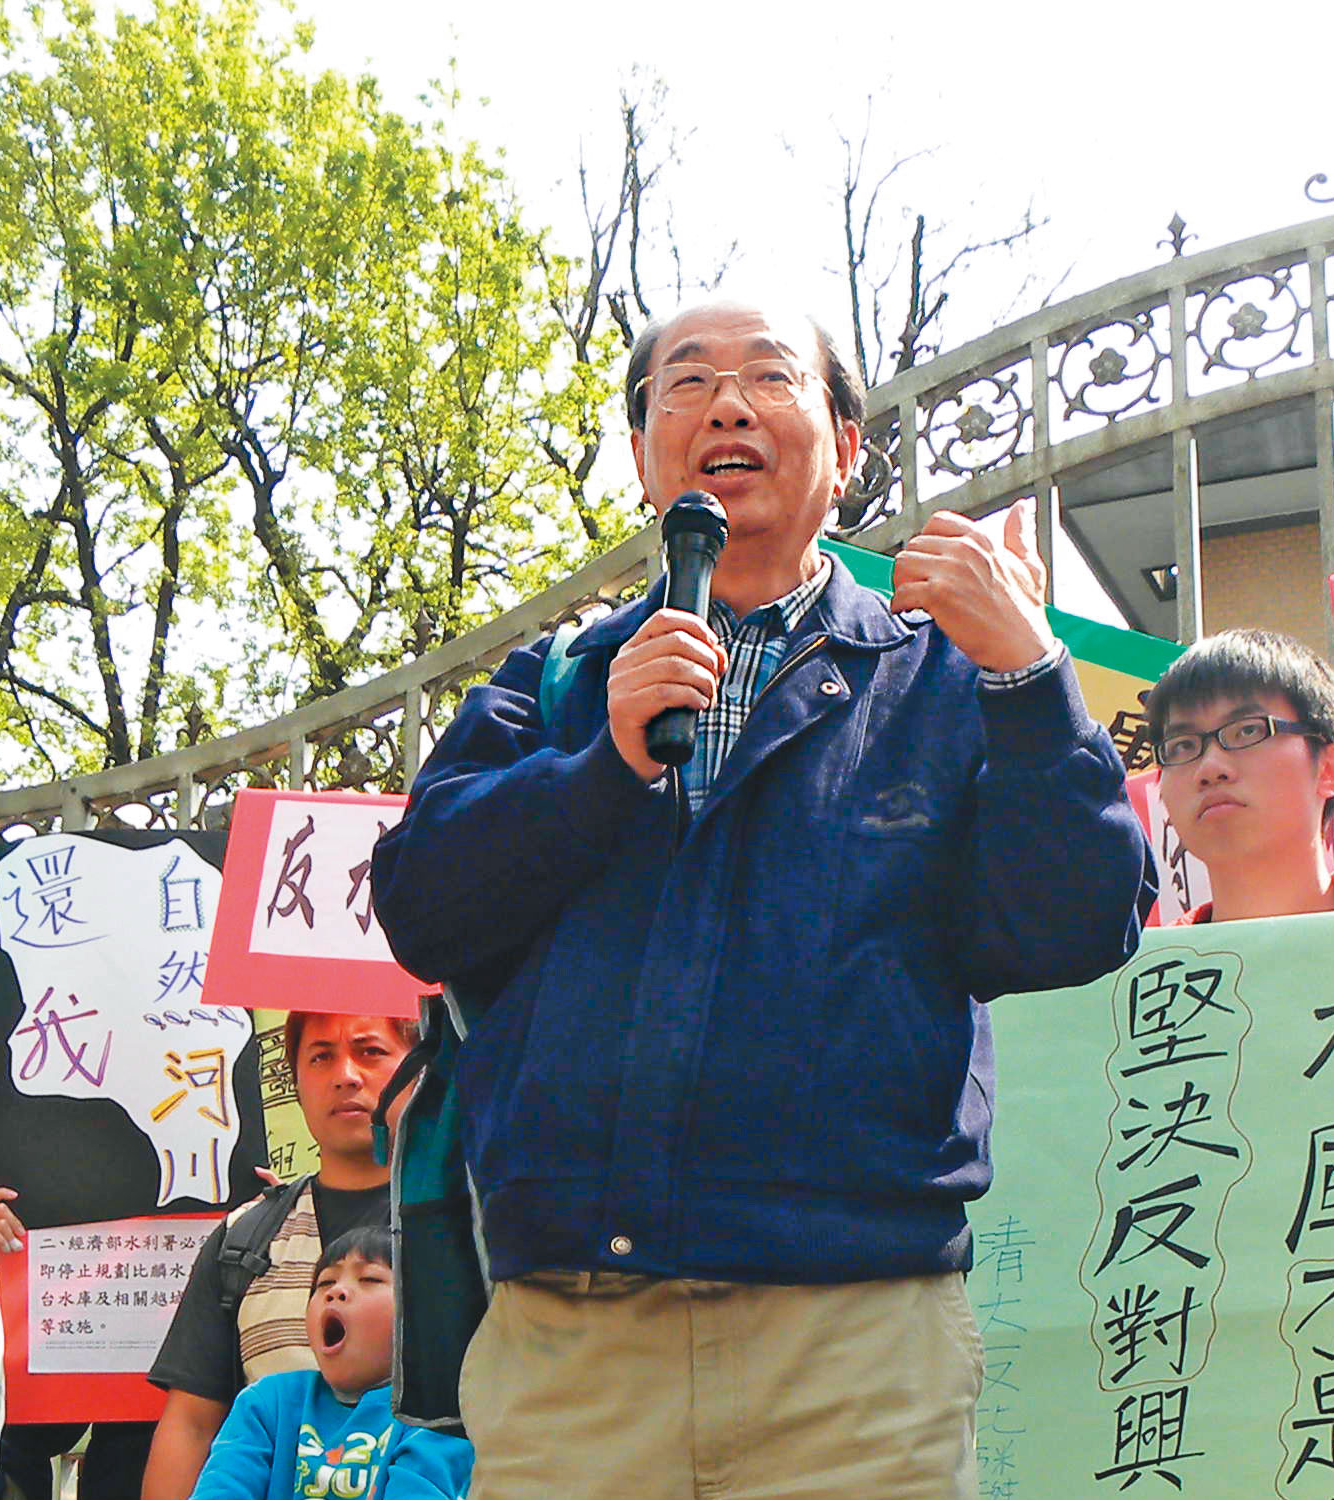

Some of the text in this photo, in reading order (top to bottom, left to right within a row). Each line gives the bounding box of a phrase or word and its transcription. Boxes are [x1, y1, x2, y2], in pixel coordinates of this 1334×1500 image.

[2, 845, 113, 1087] 還我
[143, 855, 247, 1205] 自然河川
[39, 1262, 196, 1280] 即停止規劃比麟水
